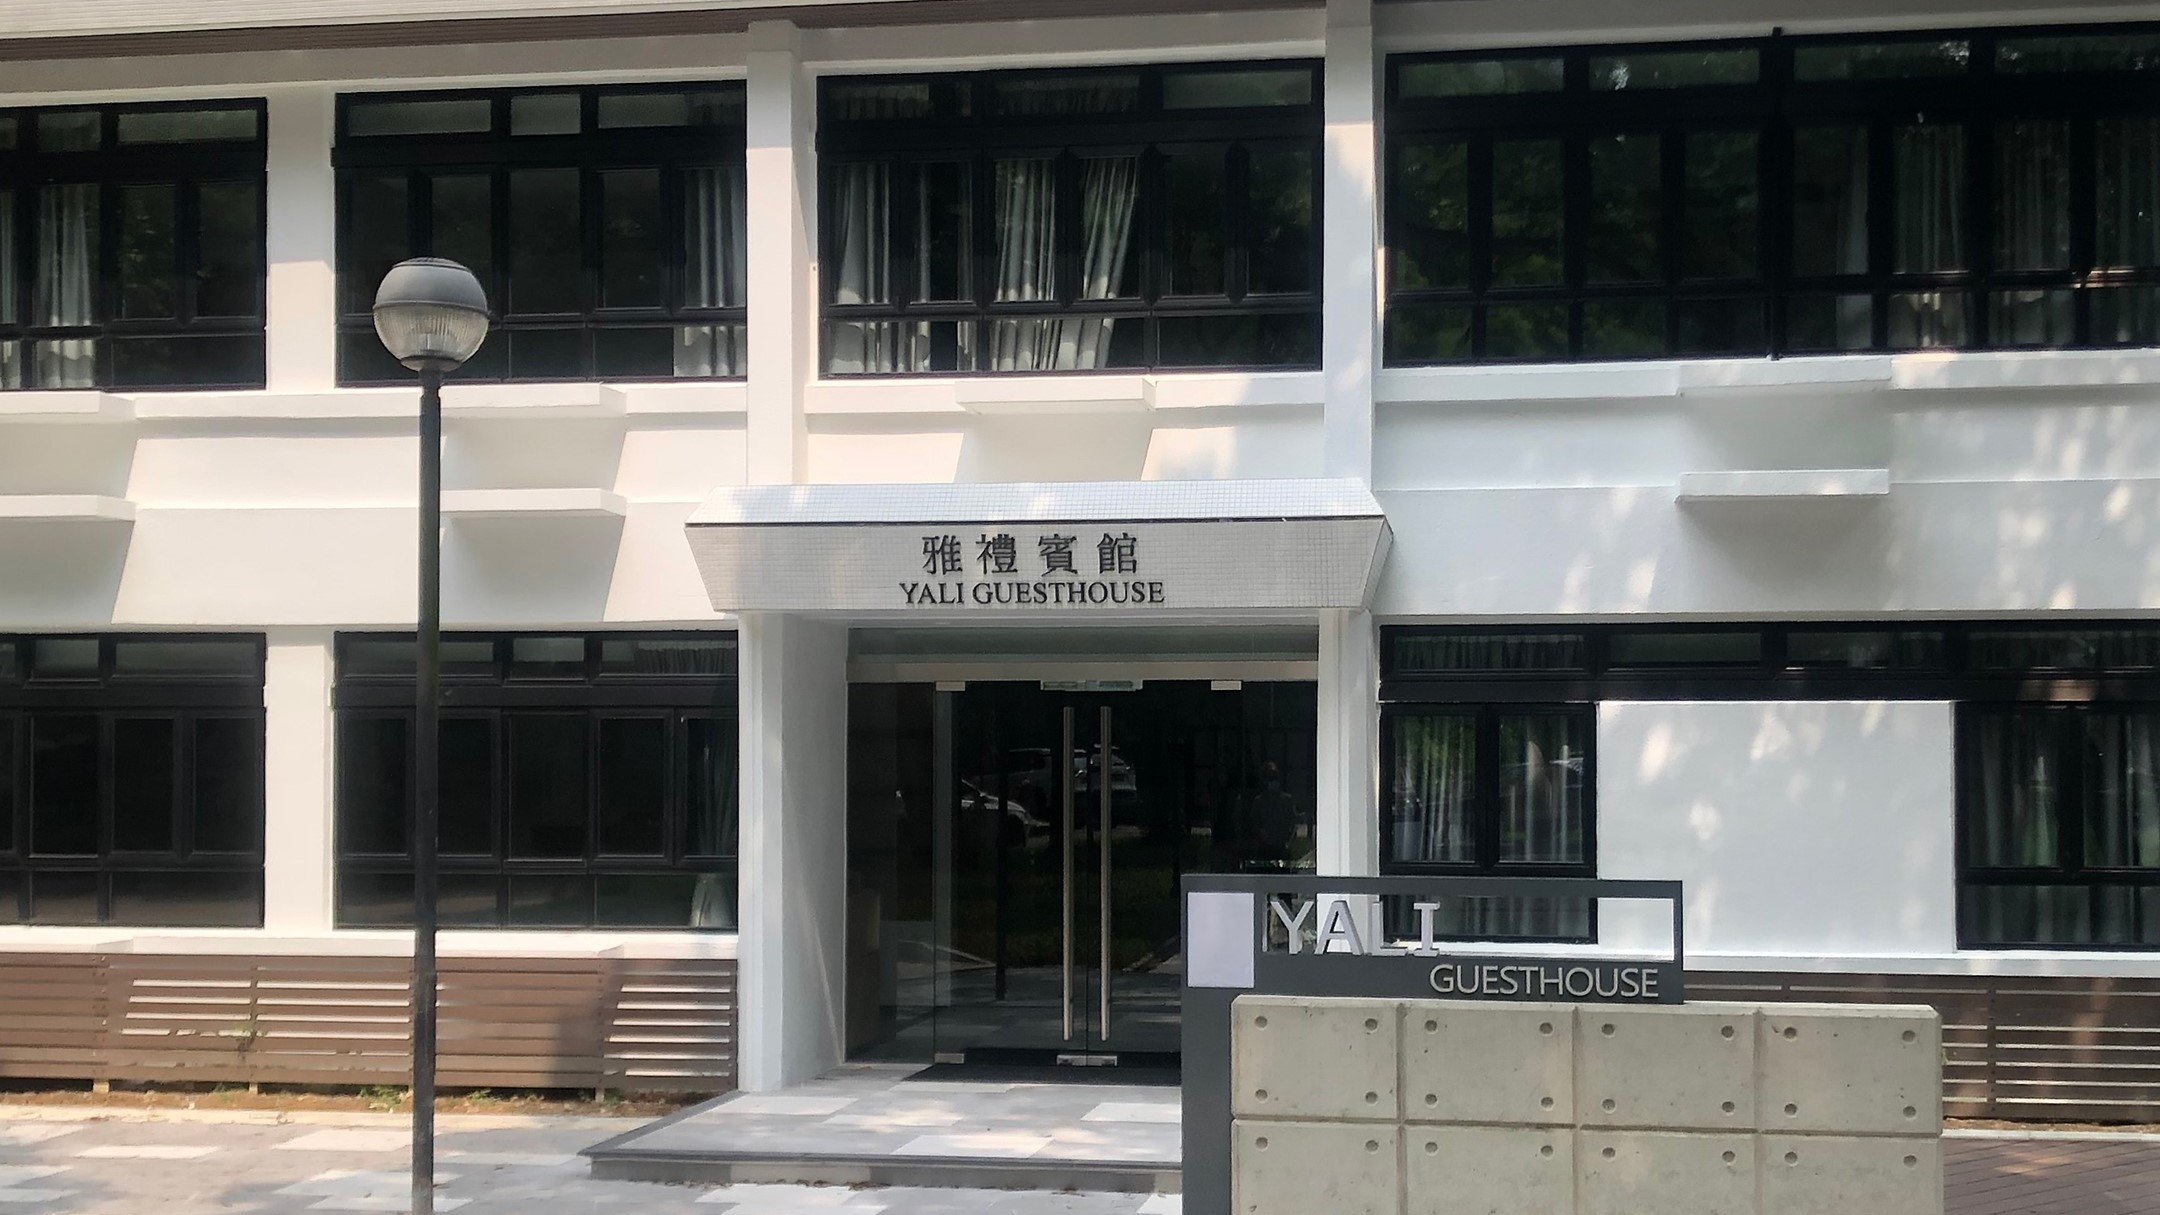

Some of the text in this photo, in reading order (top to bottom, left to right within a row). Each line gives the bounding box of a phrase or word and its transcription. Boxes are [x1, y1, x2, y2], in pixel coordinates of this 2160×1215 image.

[922, 532, 1138, 576] 雅禮賓館
[900, 581, 1165, 605] YALI GUESTHOUSE
[1269, 900, 1441, 957] YALI
[1429, 963, 1660, 998] GUESTHOUSE
